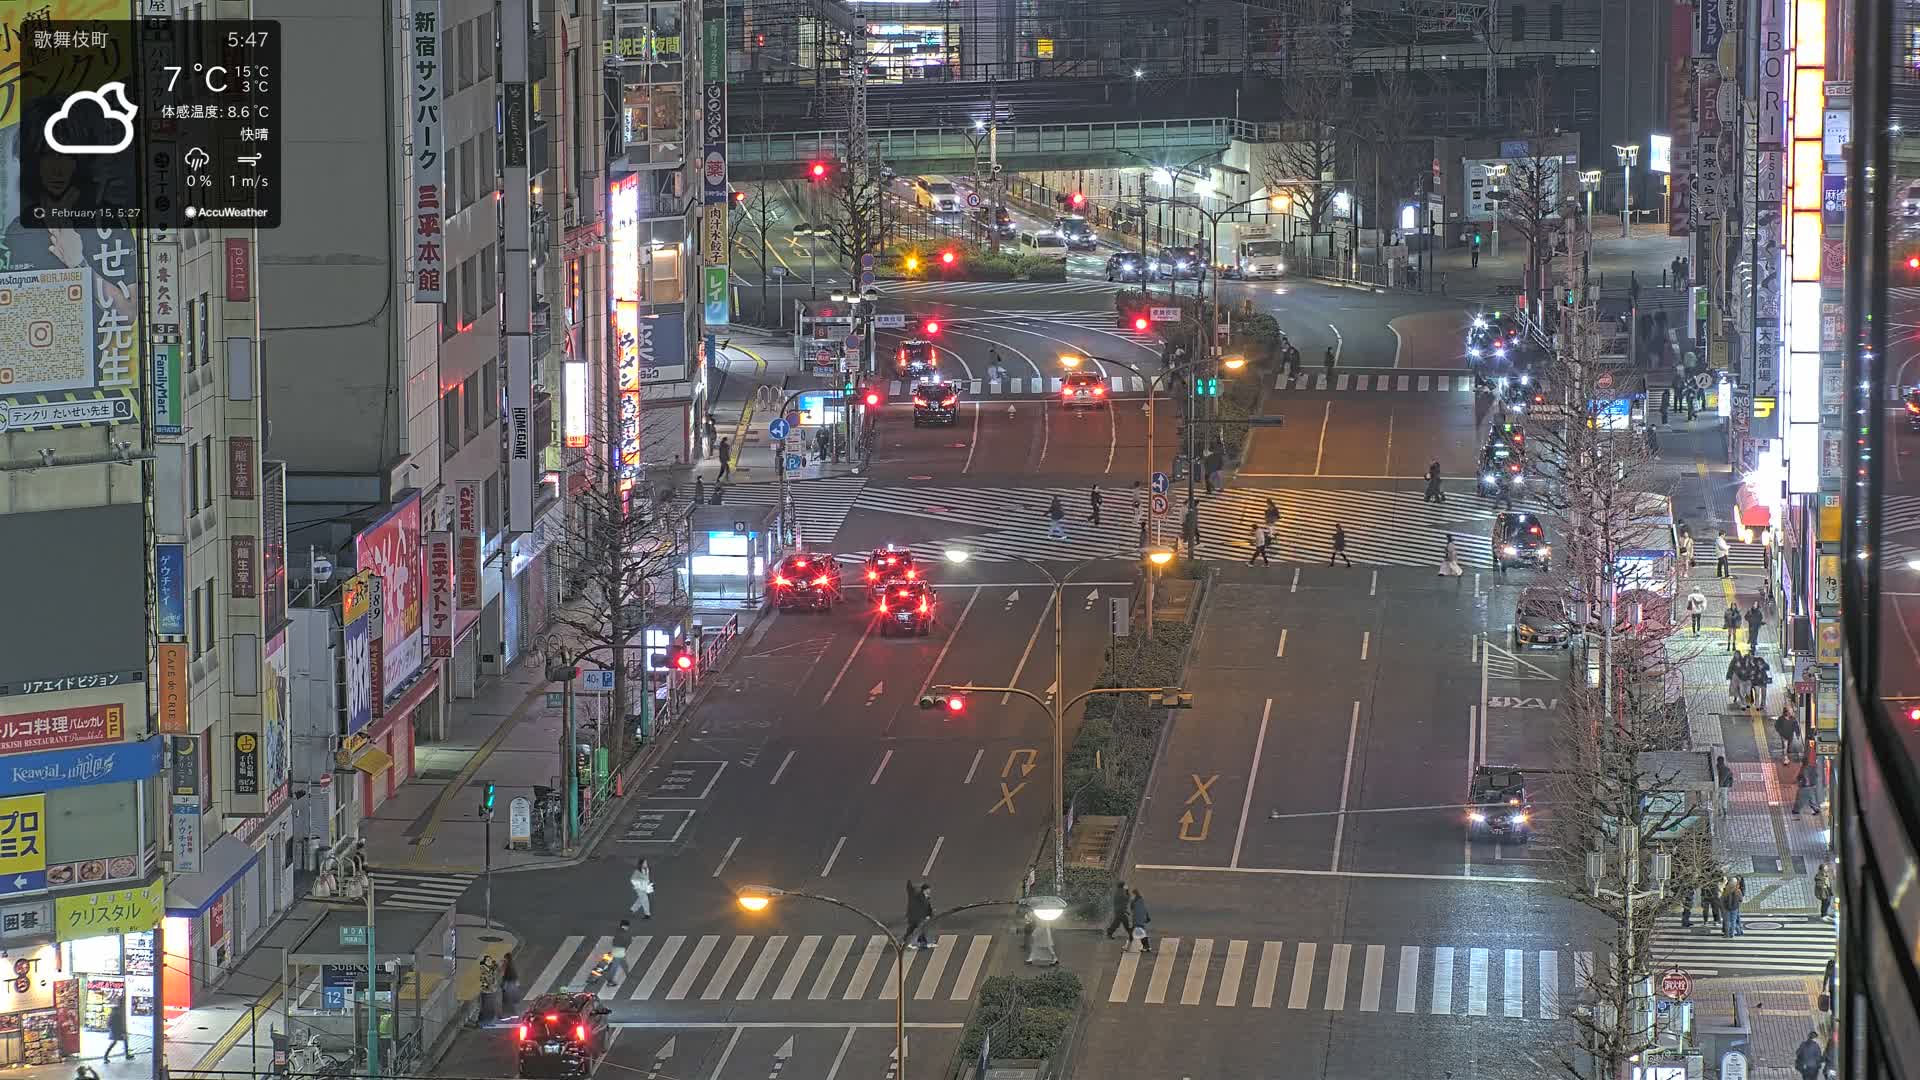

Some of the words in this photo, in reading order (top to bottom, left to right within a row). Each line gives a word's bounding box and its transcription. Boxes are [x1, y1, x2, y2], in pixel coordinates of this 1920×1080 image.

[414, 12, 438, 169] 新宿サンパーク
[706, 160, 724, 177] 薬
[417, 184, 441, 291] 三平本館
[710, 207, 722, 263] 肉汁水餃子
[0, 274, 39, 288] nstagram
[710, 275, 723, 313] レイク
[157, 324, 173, 334] 3F
[155, 353, 169, 416] FamilyMart
[13, 411, 48, 423] テンクリ
[53, 402, 110, 418] たいせい先生
[512, 407, 528, 460] HOMEGAME
[1827, 496, 1838, 506] 3F
[431, 542, 448, 630] 三平ストア
[1825, 576, 1838, 601] ねぎし
[23, 677, 74, 694] リアエイド
[77, 673, 119, 689] ビジョン
[0, 739, 22, 750] RKISH
[24, 735, 68, 747] RESTAURANT
[0, 811, 39, 833] プロ
[0, 836, 39, 859] ミス
[4, 911, 38, 932] 囲碁
[68, 903, 141, 928] クリスタル
[325, 991, 342, 1004] 12
